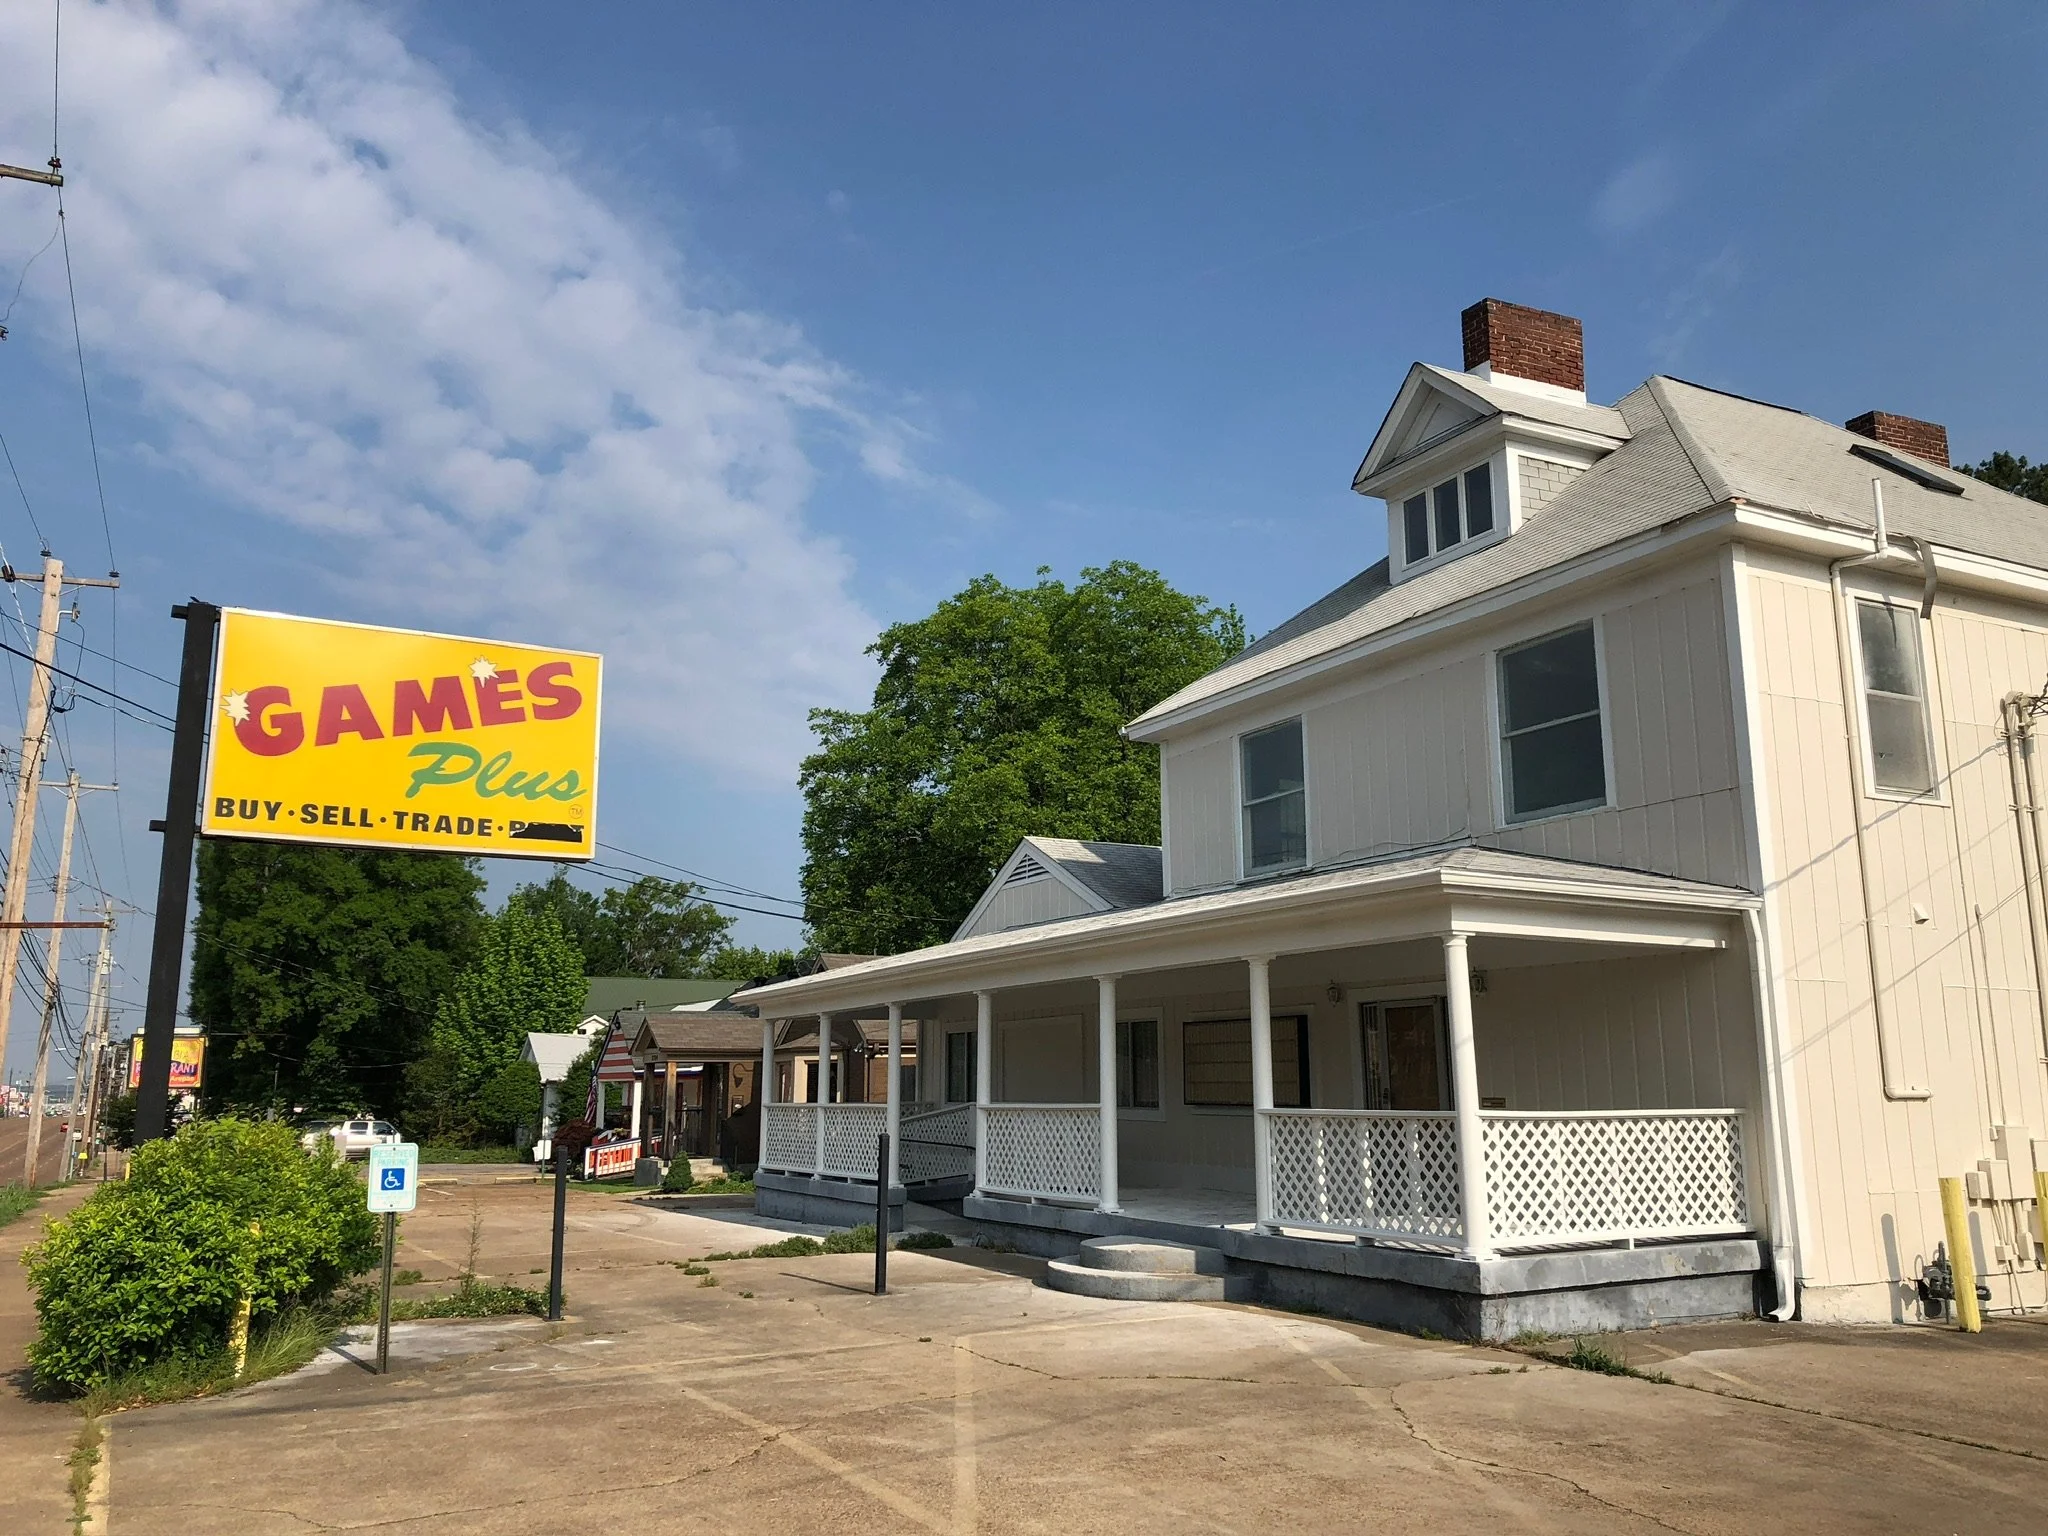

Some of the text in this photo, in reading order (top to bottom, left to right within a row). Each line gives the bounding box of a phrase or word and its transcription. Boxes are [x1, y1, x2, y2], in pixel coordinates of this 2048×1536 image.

[234, 662, 583, 756] GAMES
[405, 742, 587, 801] Plus
[214, 797, 282, 821] BUY
[300, 803, 374, 828] SELL
[393, 811, 493, 837] TRADE
